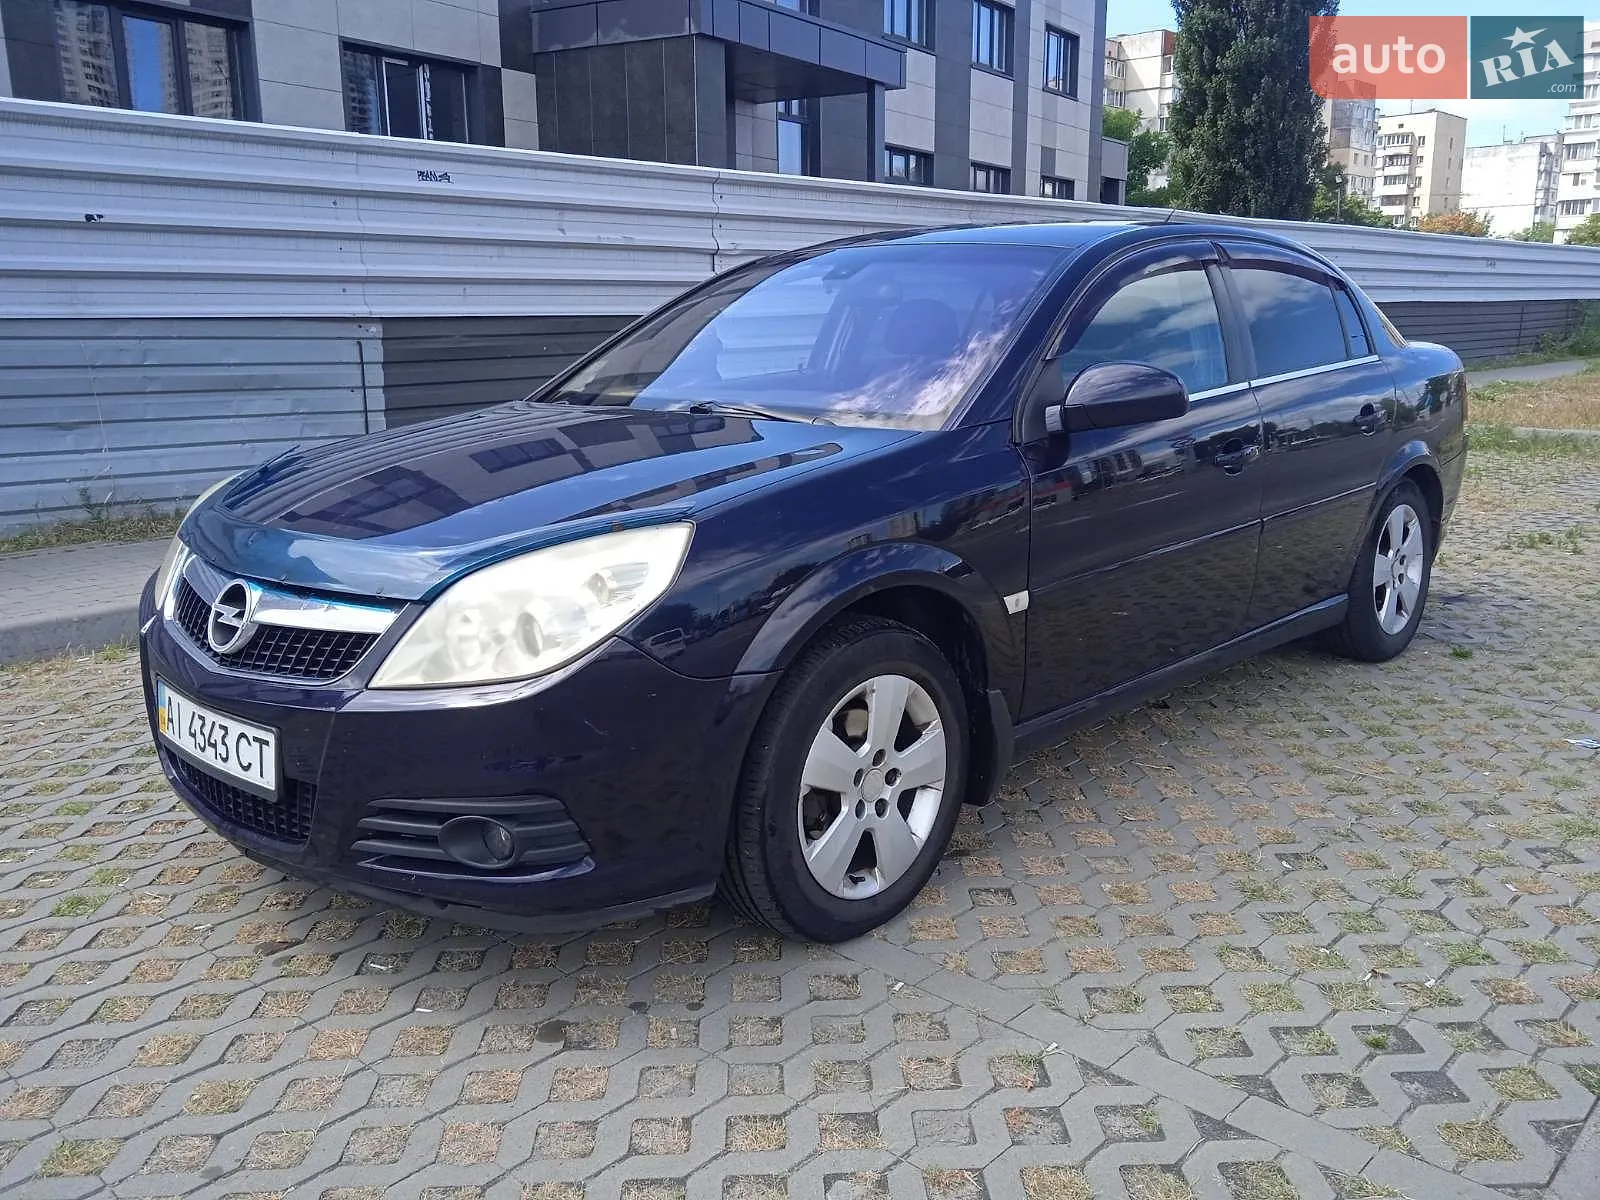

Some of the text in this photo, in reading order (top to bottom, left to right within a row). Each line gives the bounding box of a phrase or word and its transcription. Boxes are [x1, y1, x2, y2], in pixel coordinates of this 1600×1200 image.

[166, 695, 270, 779] AI 4343 CT
